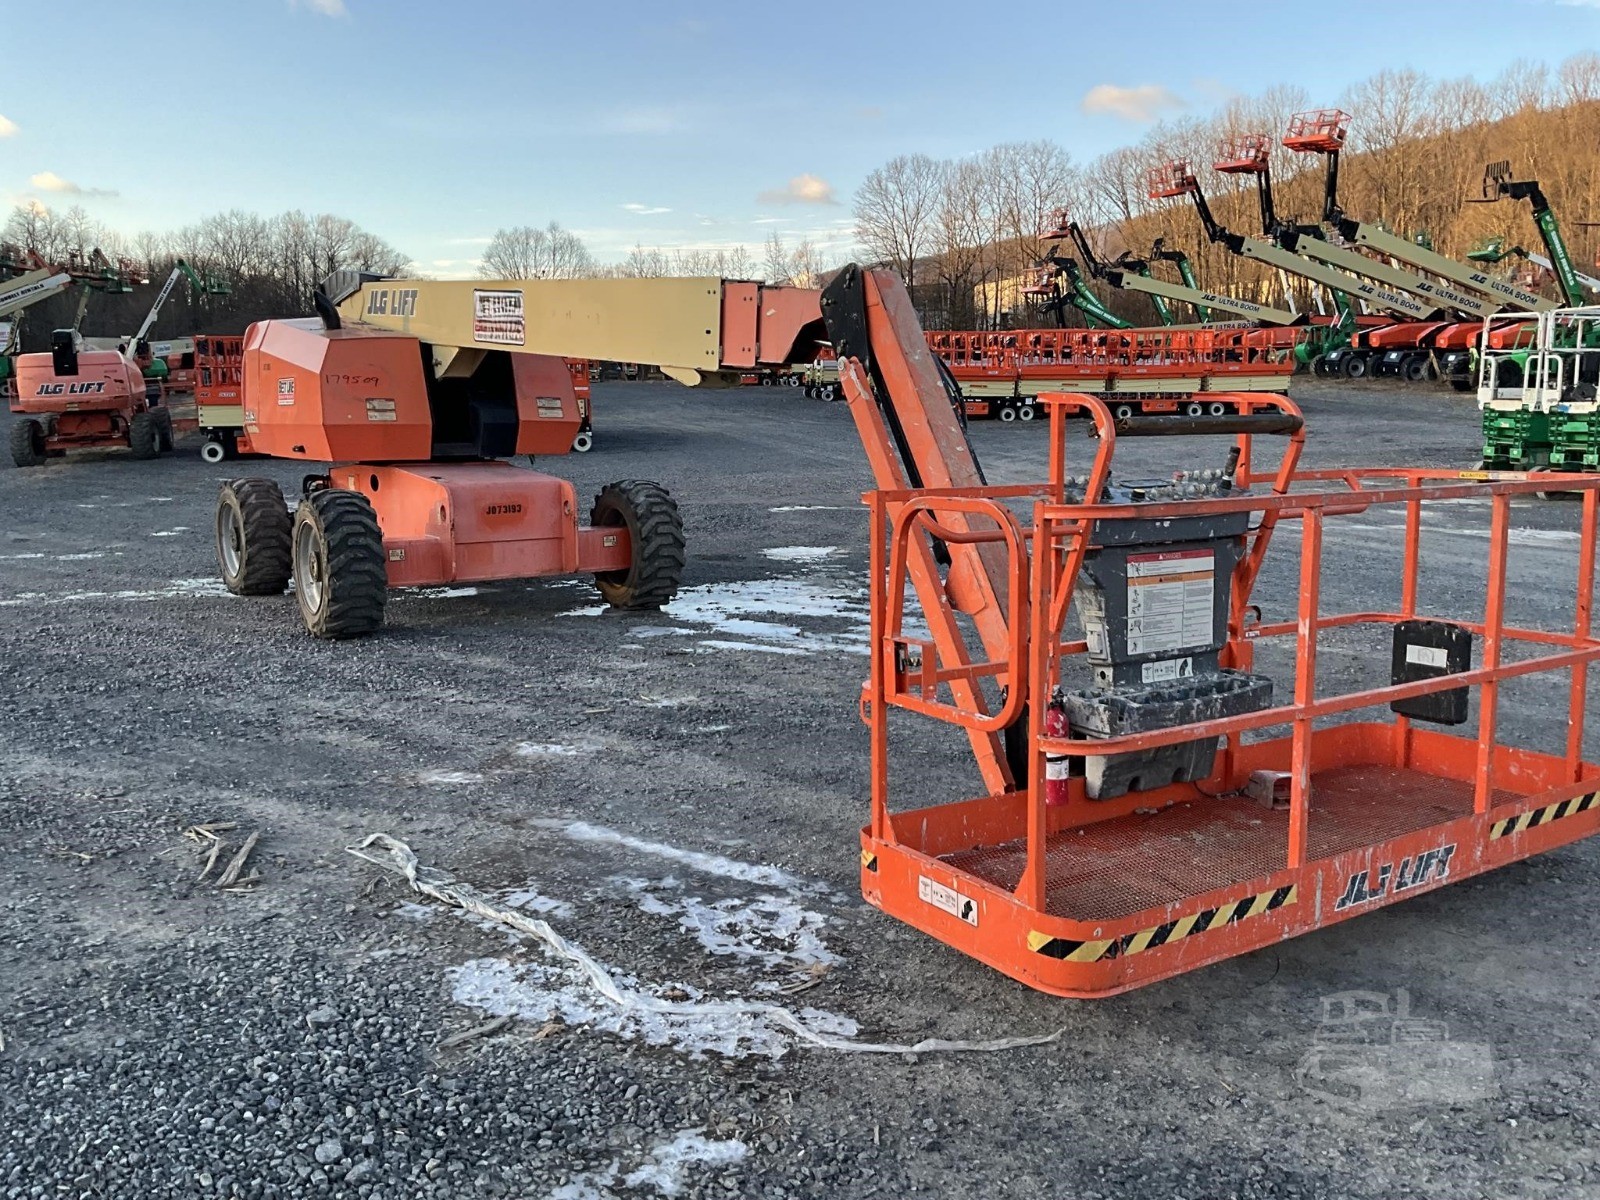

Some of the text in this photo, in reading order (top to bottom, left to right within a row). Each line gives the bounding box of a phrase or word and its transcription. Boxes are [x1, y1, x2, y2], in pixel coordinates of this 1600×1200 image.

[367, 288, 419, 317] JLG LIFT
[1201, 293, 1260, 312] JLG ULTRA BOOM
[1358, 284, 1422, 313] JLG ULTRA BOOM
[1416, 282, 1482, 310] JLG ULTRA BOOM
[1469, 273, 1538, 306] JLG ULTRA BOOM
[36, 381, 106, 396] JLG LIFT
[325, 374, 380, 388] 179509
[1392, 842, 1458, 893] LIFT
